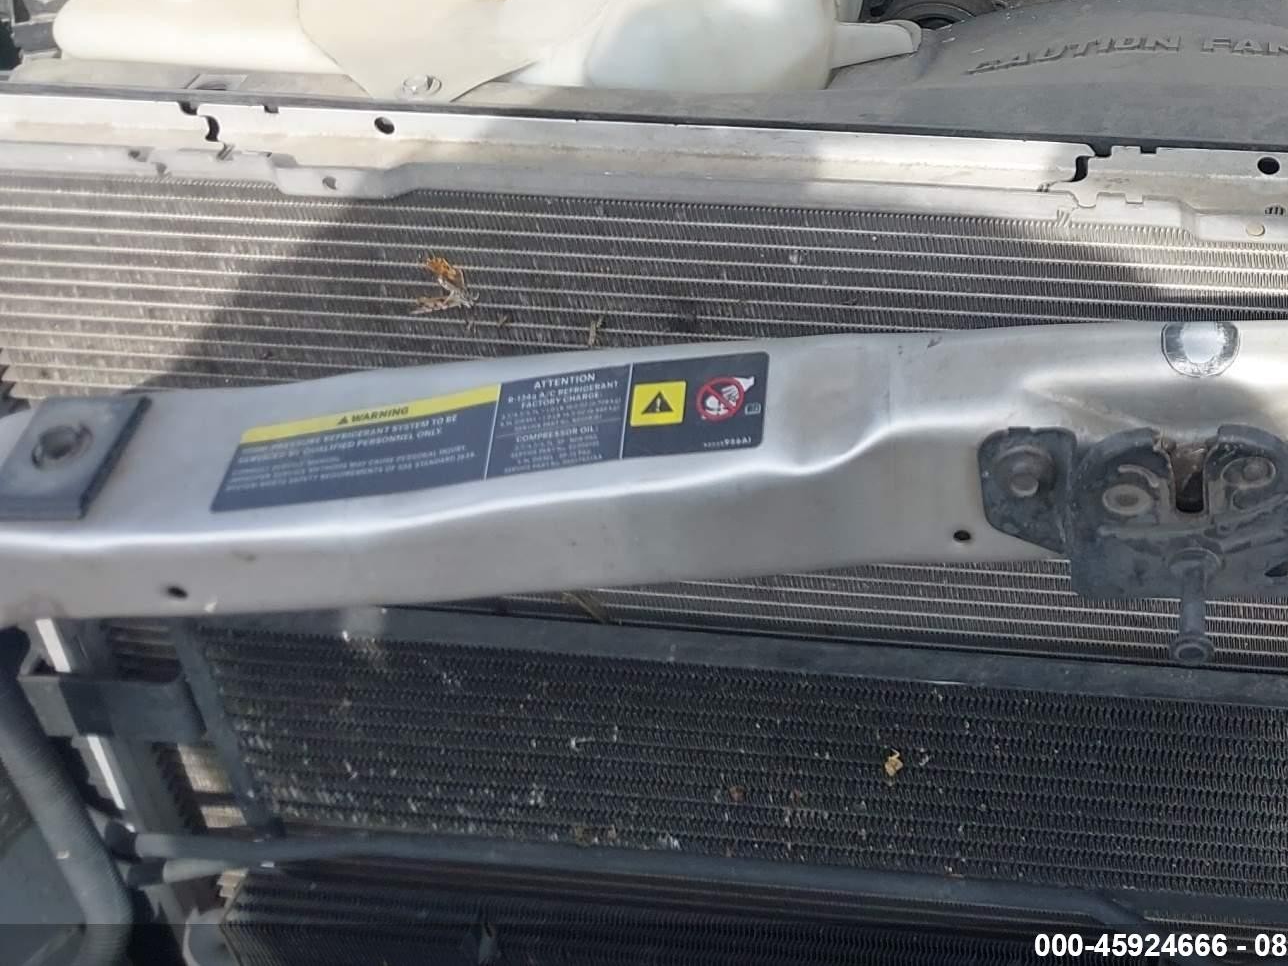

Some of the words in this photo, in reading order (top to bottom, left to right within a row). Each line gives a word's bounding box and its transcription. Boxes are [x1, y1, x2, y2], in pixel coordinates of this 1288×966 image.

[964, 34, 1182, 76] CAUTION
[533, 372, 597, 390] ATTENTION
[557, 380, 619, 395] REFRIGERANT
[520, 397, 561, 410] FACTORY
[351, 406, 410, 422] WARNING
[391, 419, 430, 434] SYSTEM
[356, 432, 415, 449] PERSONNEL
[416, 427, 443, 439] ONLY
[515, 427, 579, 443] COMPRESSOR
